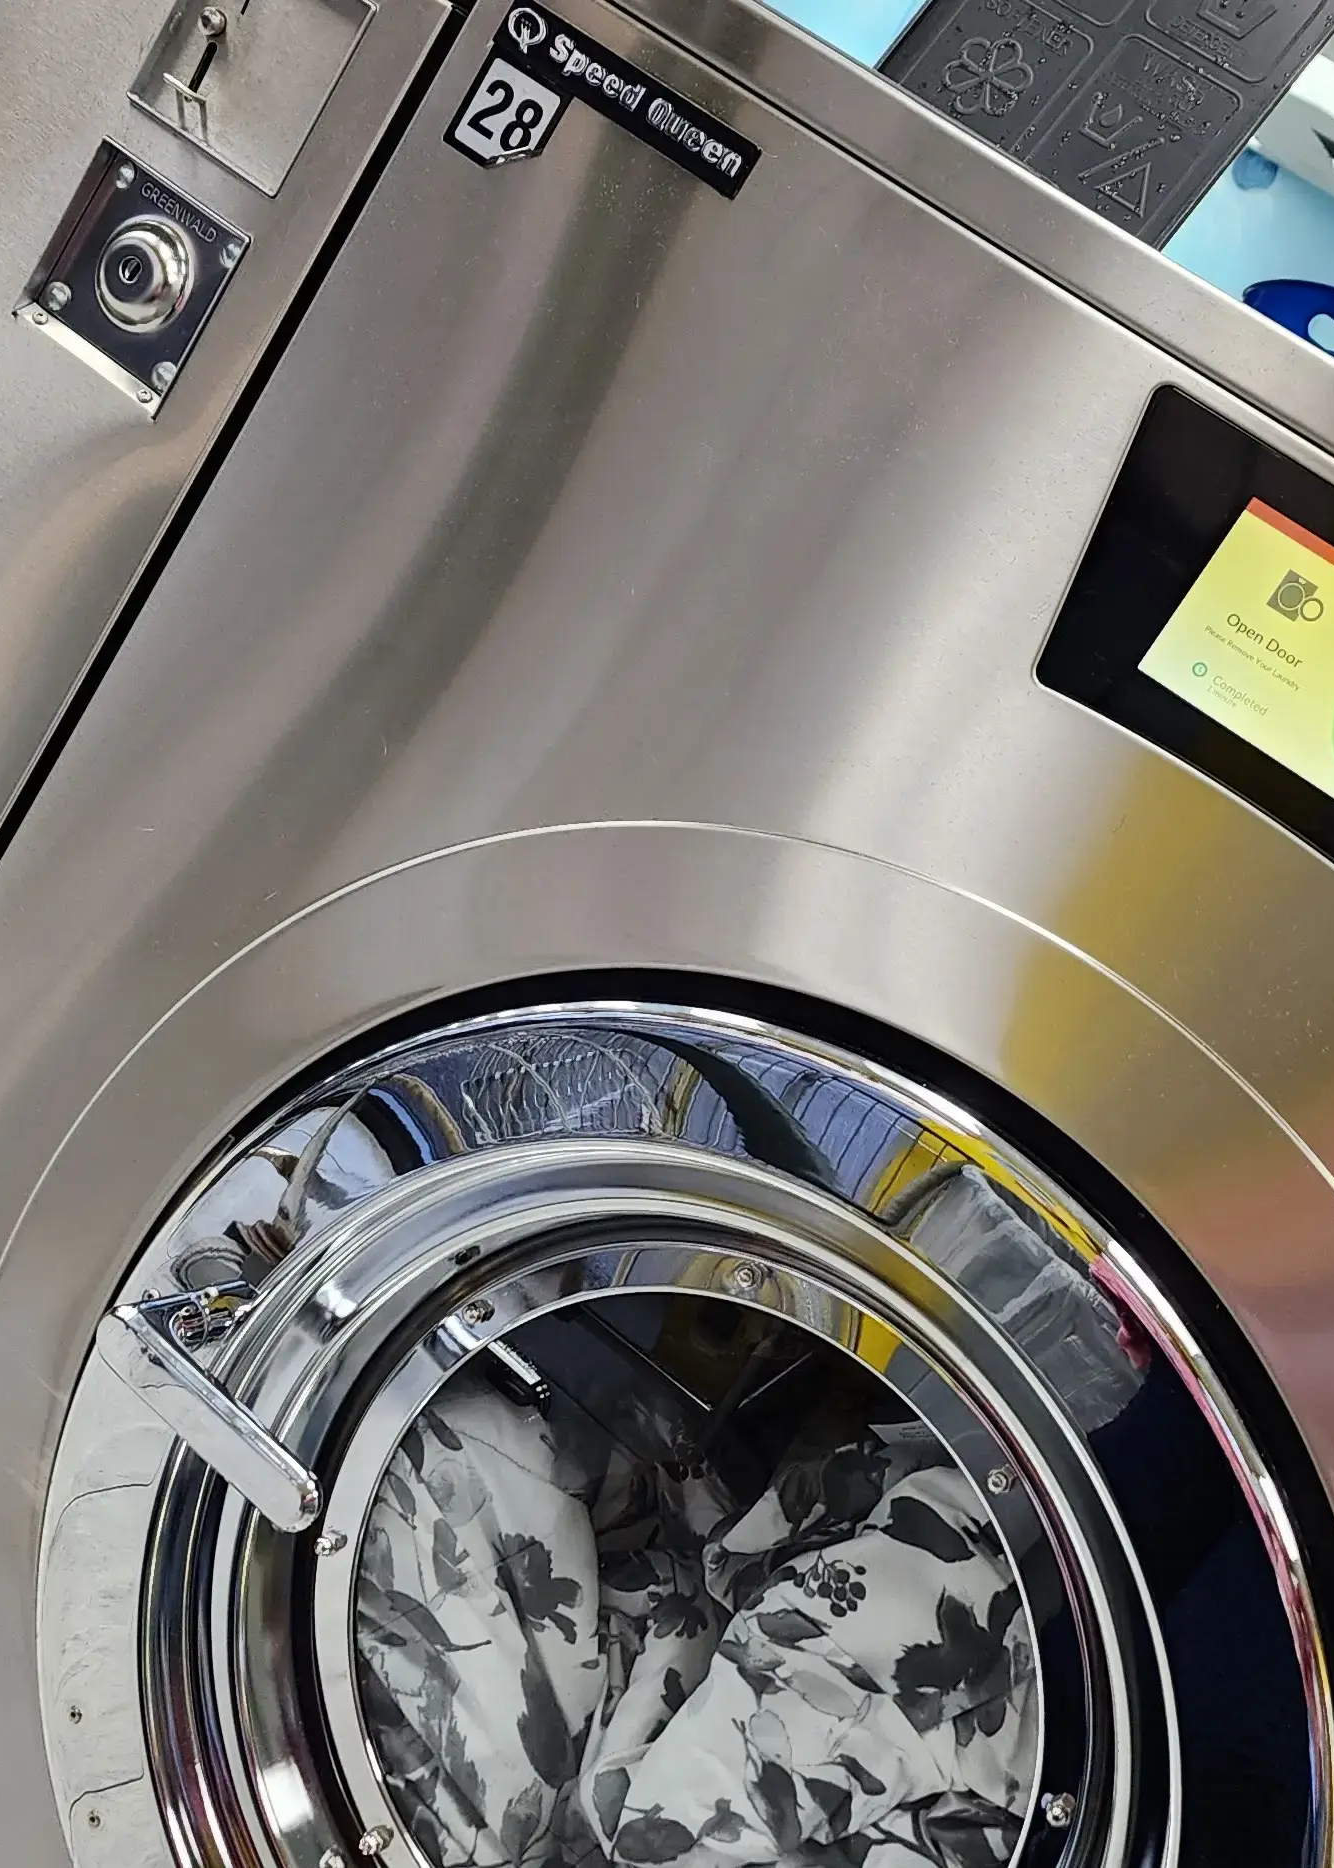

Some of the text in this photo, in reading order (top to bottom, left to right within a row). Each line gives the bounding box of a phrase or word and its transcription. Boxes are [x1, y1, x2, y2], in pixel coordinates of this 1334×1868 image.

[467, 79, 544, 152] 28
[550, 33, 647, 112] Speed
[645, 97, 743, 178] Queen
[141, 182, 217, 243] GREENWALD
[1204, 625, 1301, 692] Please Remove Your Laundry
[1227, 613, 1303, 668] Open Door
[1212, 675, 1269, 717] Completed
